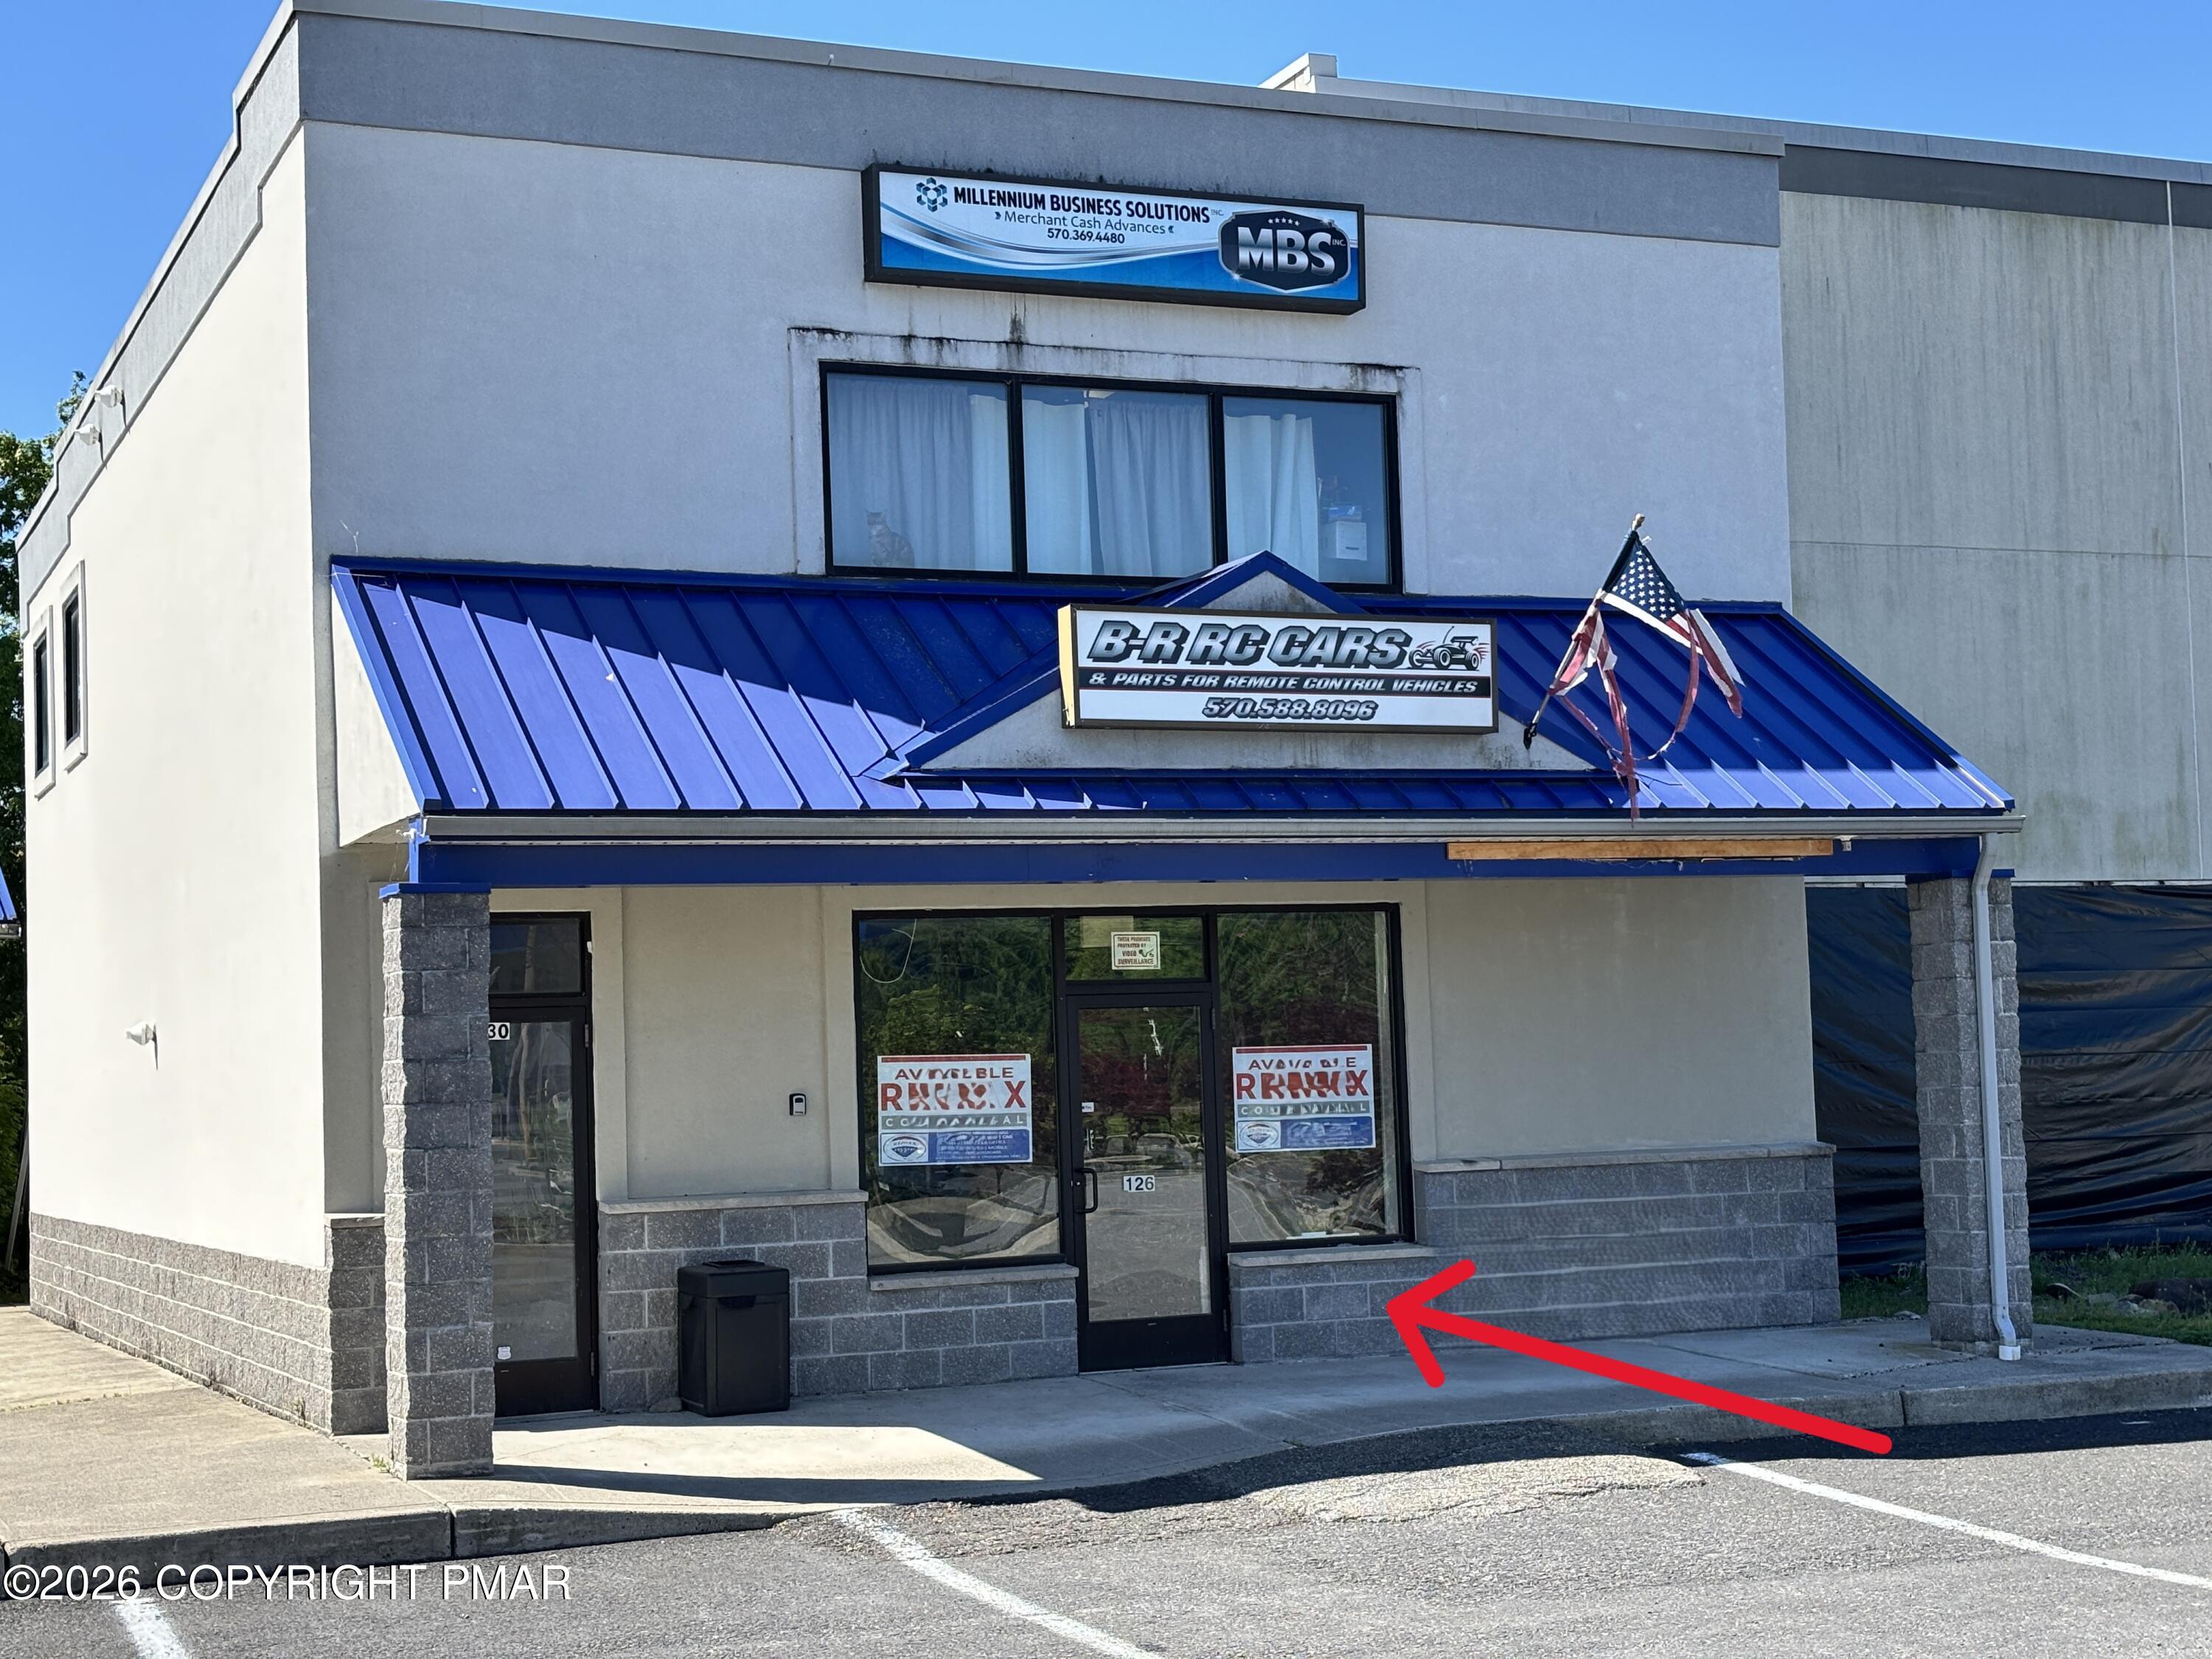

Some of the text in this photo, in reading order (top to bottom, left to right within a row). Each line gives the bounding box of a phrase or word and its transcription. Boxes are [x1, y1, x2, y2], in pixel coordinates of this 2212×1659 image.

[953, 186, 1046, 211] MILLENNIUM
[1050, 195, 1122, 217] BUSINESS
[1126, 201, 1211, 223] SOLUTIONS
[1004, 210, 1166, 234] Merchant Cash Advances
[1047, 228, 1125, 244] 570.369.4480
[1237, 226, 1336, 276] MBS
[1087, 620, 1413, 669] B-R RC CARS
[1088, 672, 1478, 693] & PARTS FOR REMOTE CONTROL VEHICLES
[1203, 697, 1379, 720] 570.588.8096
[1126, 1176, 1155, 1192] 126
